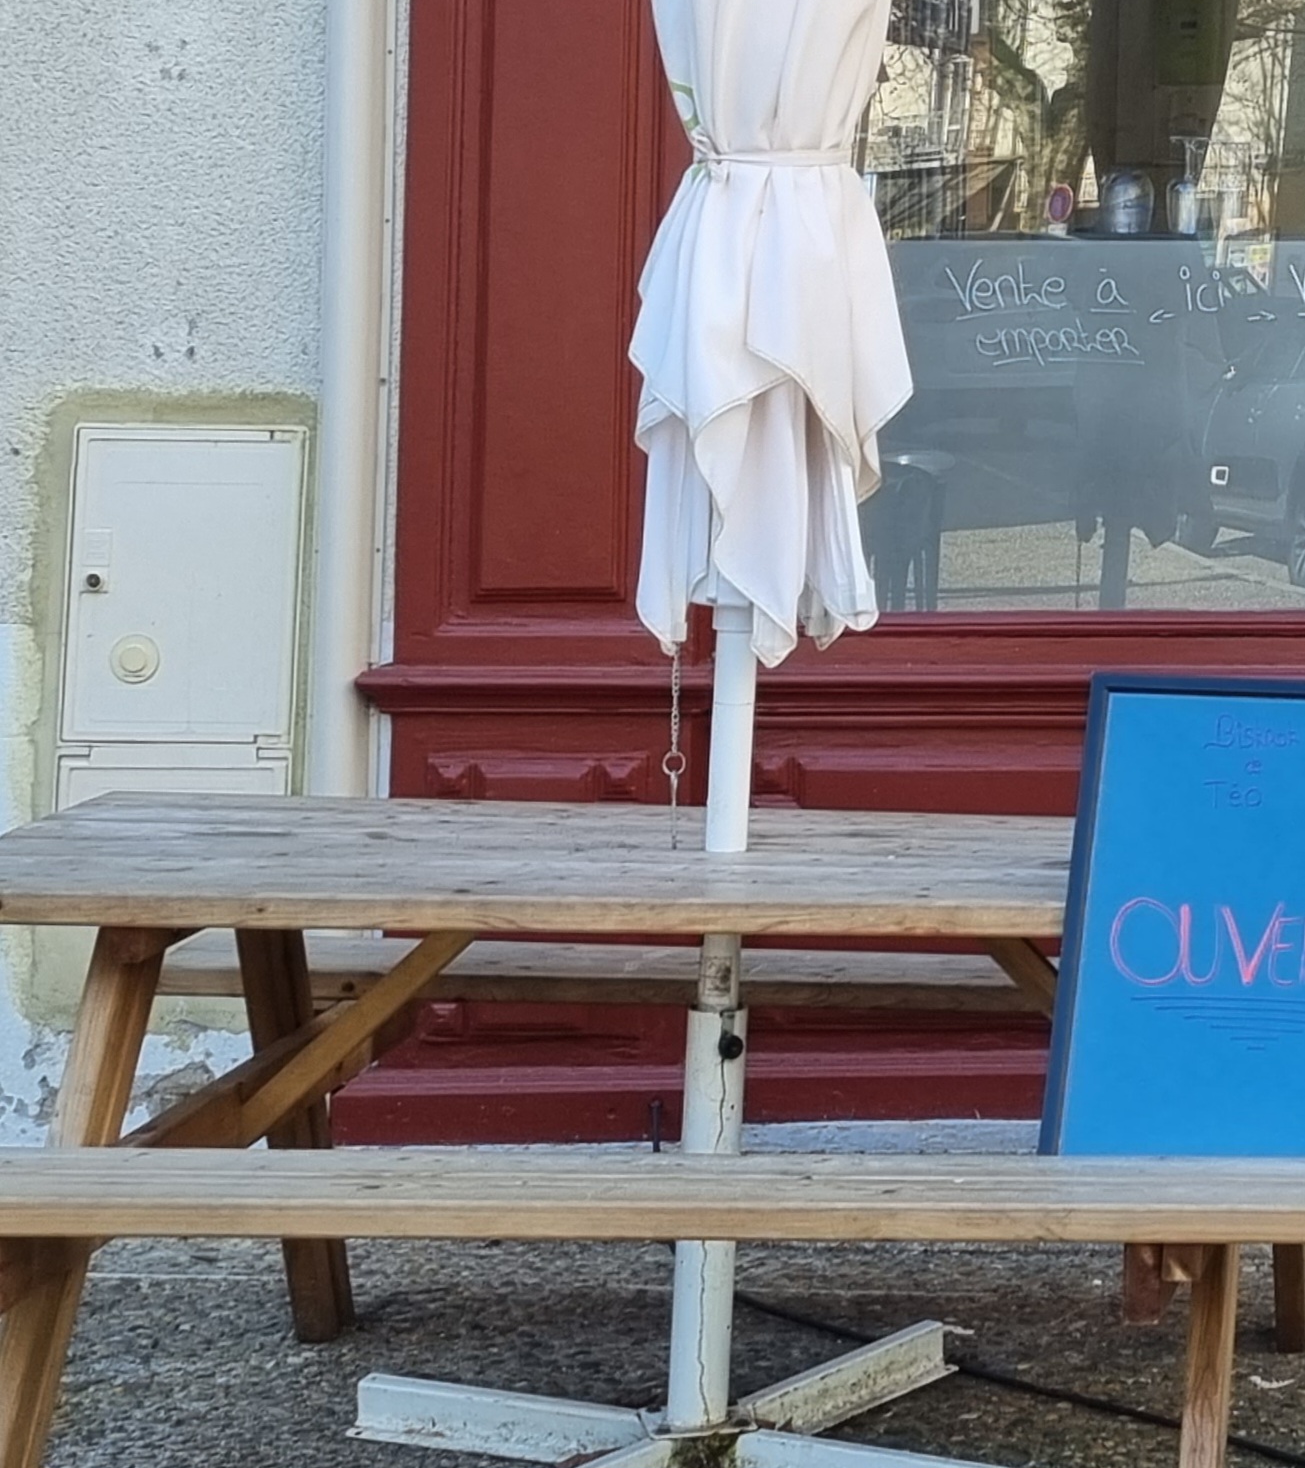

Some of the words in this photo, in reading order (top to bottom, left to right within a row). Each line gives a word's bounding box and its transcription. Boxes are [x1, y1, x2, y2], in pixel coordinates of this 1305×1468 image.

[945, 259, 1067, 311] Vente
[1096, 268, 1129, 305] à
[1180, 266, 1225, 311] ici
[976, 317, 1139, 366] emporter
